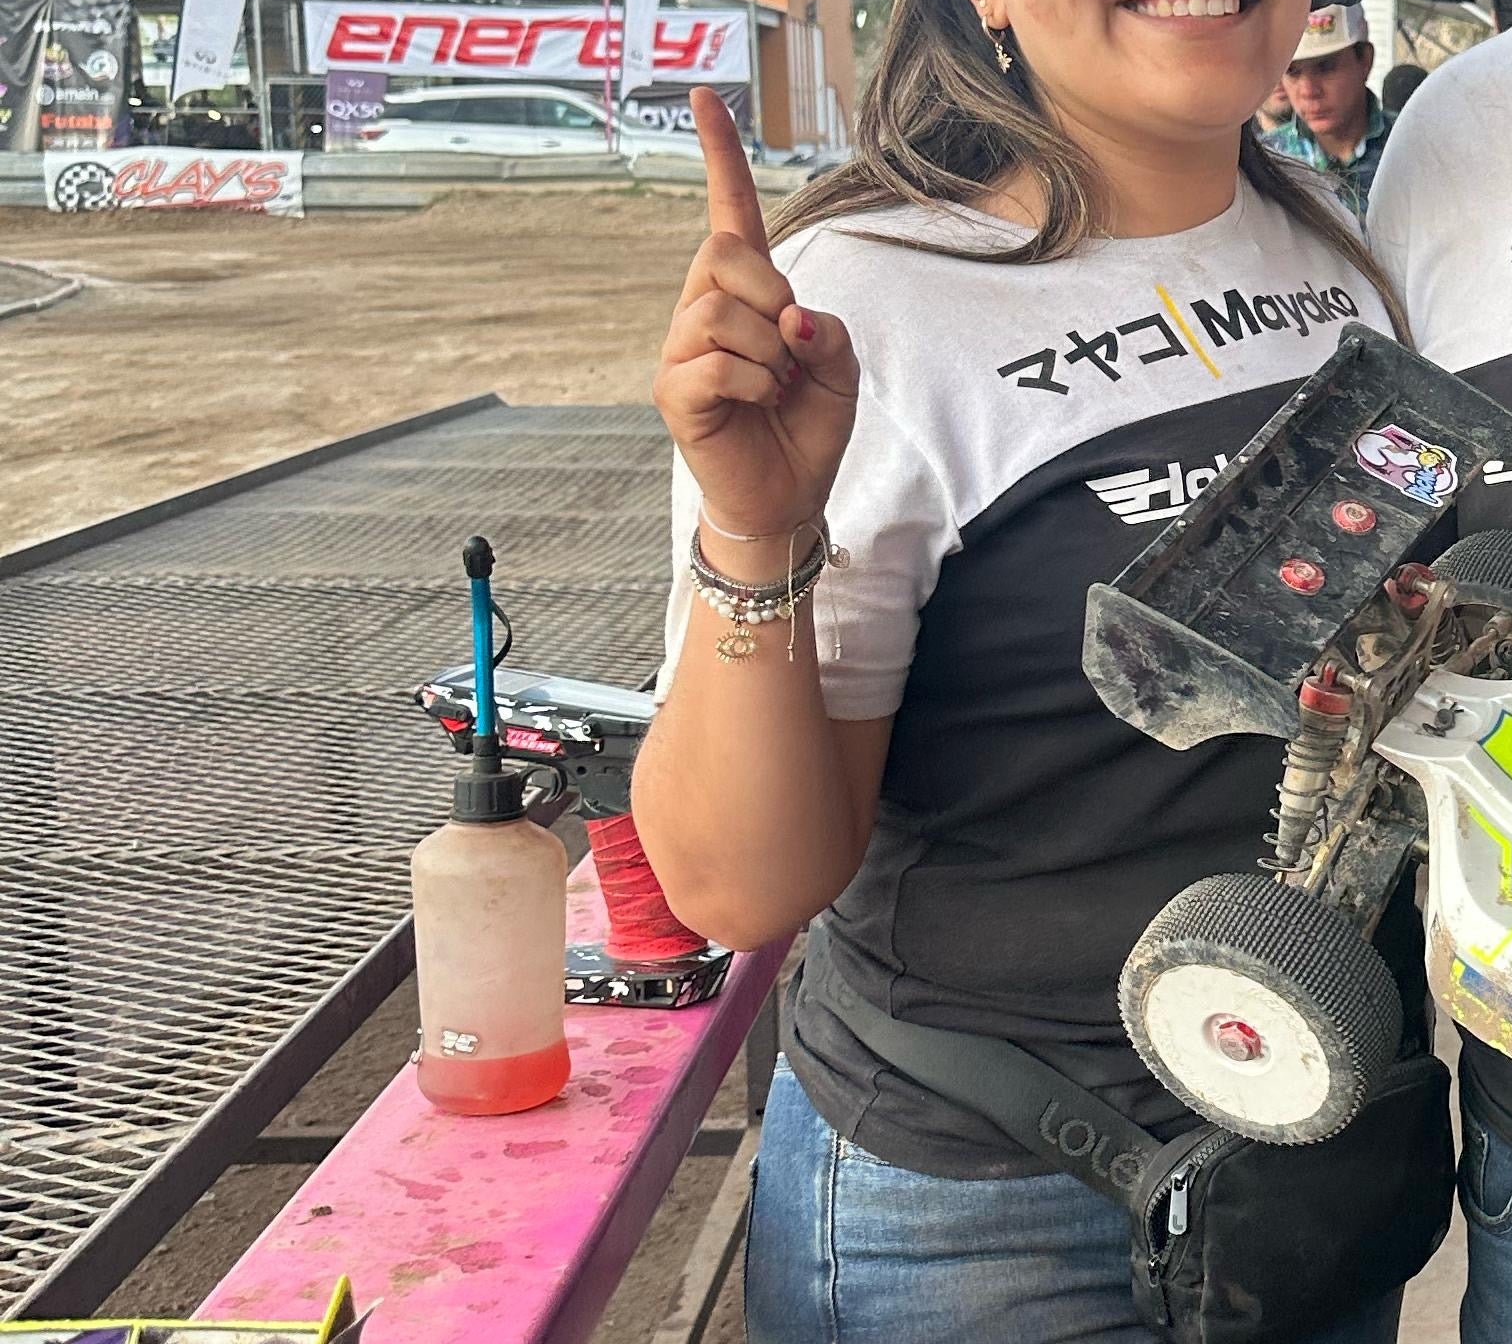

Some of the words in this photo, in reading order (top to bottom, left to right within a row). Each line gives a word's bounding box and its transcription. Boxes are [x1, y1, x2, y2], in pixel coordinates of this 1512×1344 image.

[112, 159, 286, 202] CLAY'S
[1189, 280, 1360, 348] Mayako
[997, 312, 1188, 396] マヤコ
